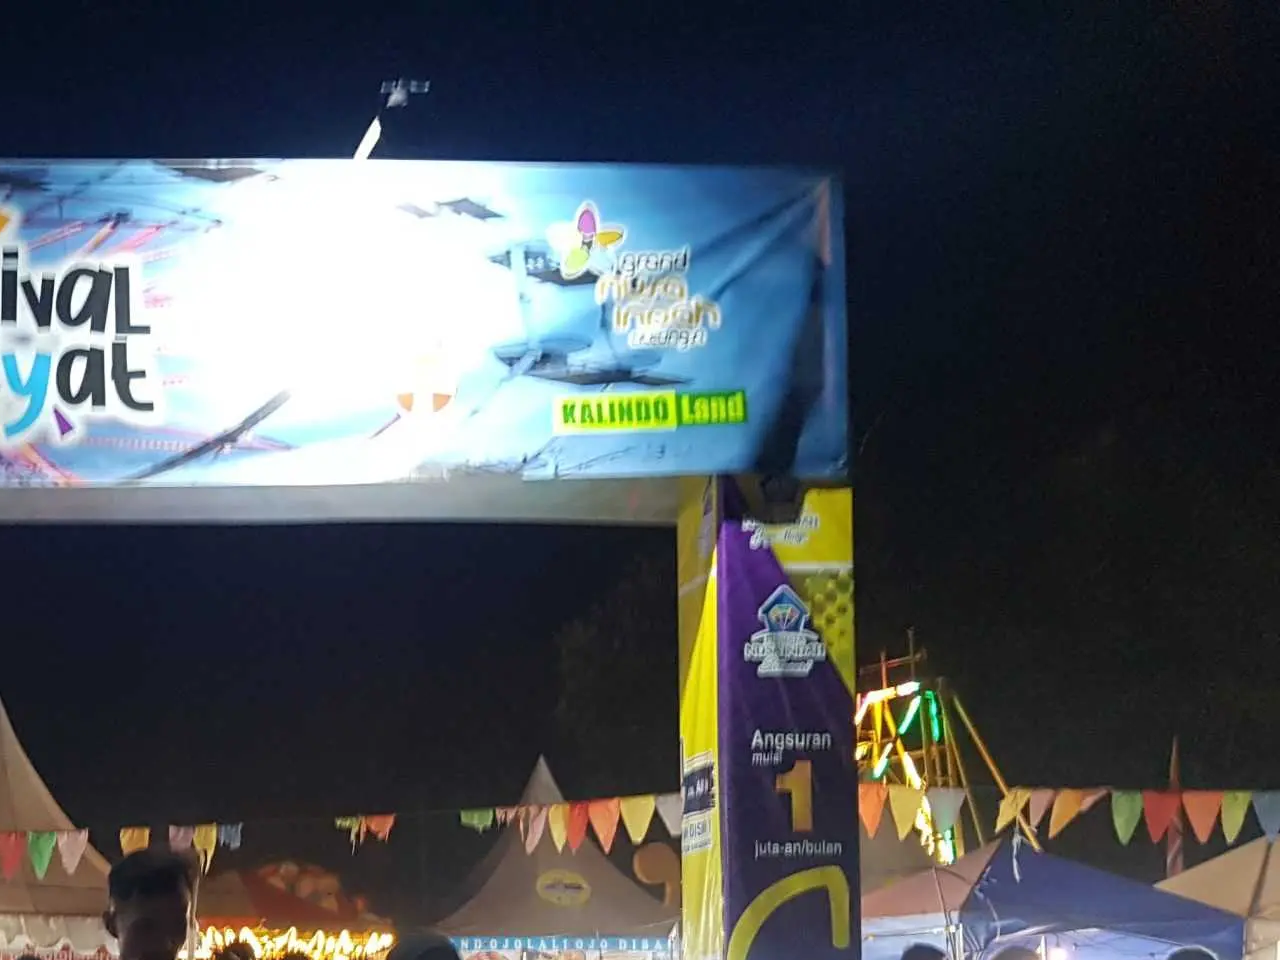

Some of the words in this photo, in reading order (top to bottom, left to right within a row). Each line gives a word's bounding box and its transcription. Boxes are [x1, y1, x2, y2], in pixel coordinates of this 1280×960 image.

[680, 391, 744, 426] Land
[751, 729, 831, 751] Angsuran
[775, 759, 813, 832] 1
[754, 839, 842, 860] juta-an/bulan
